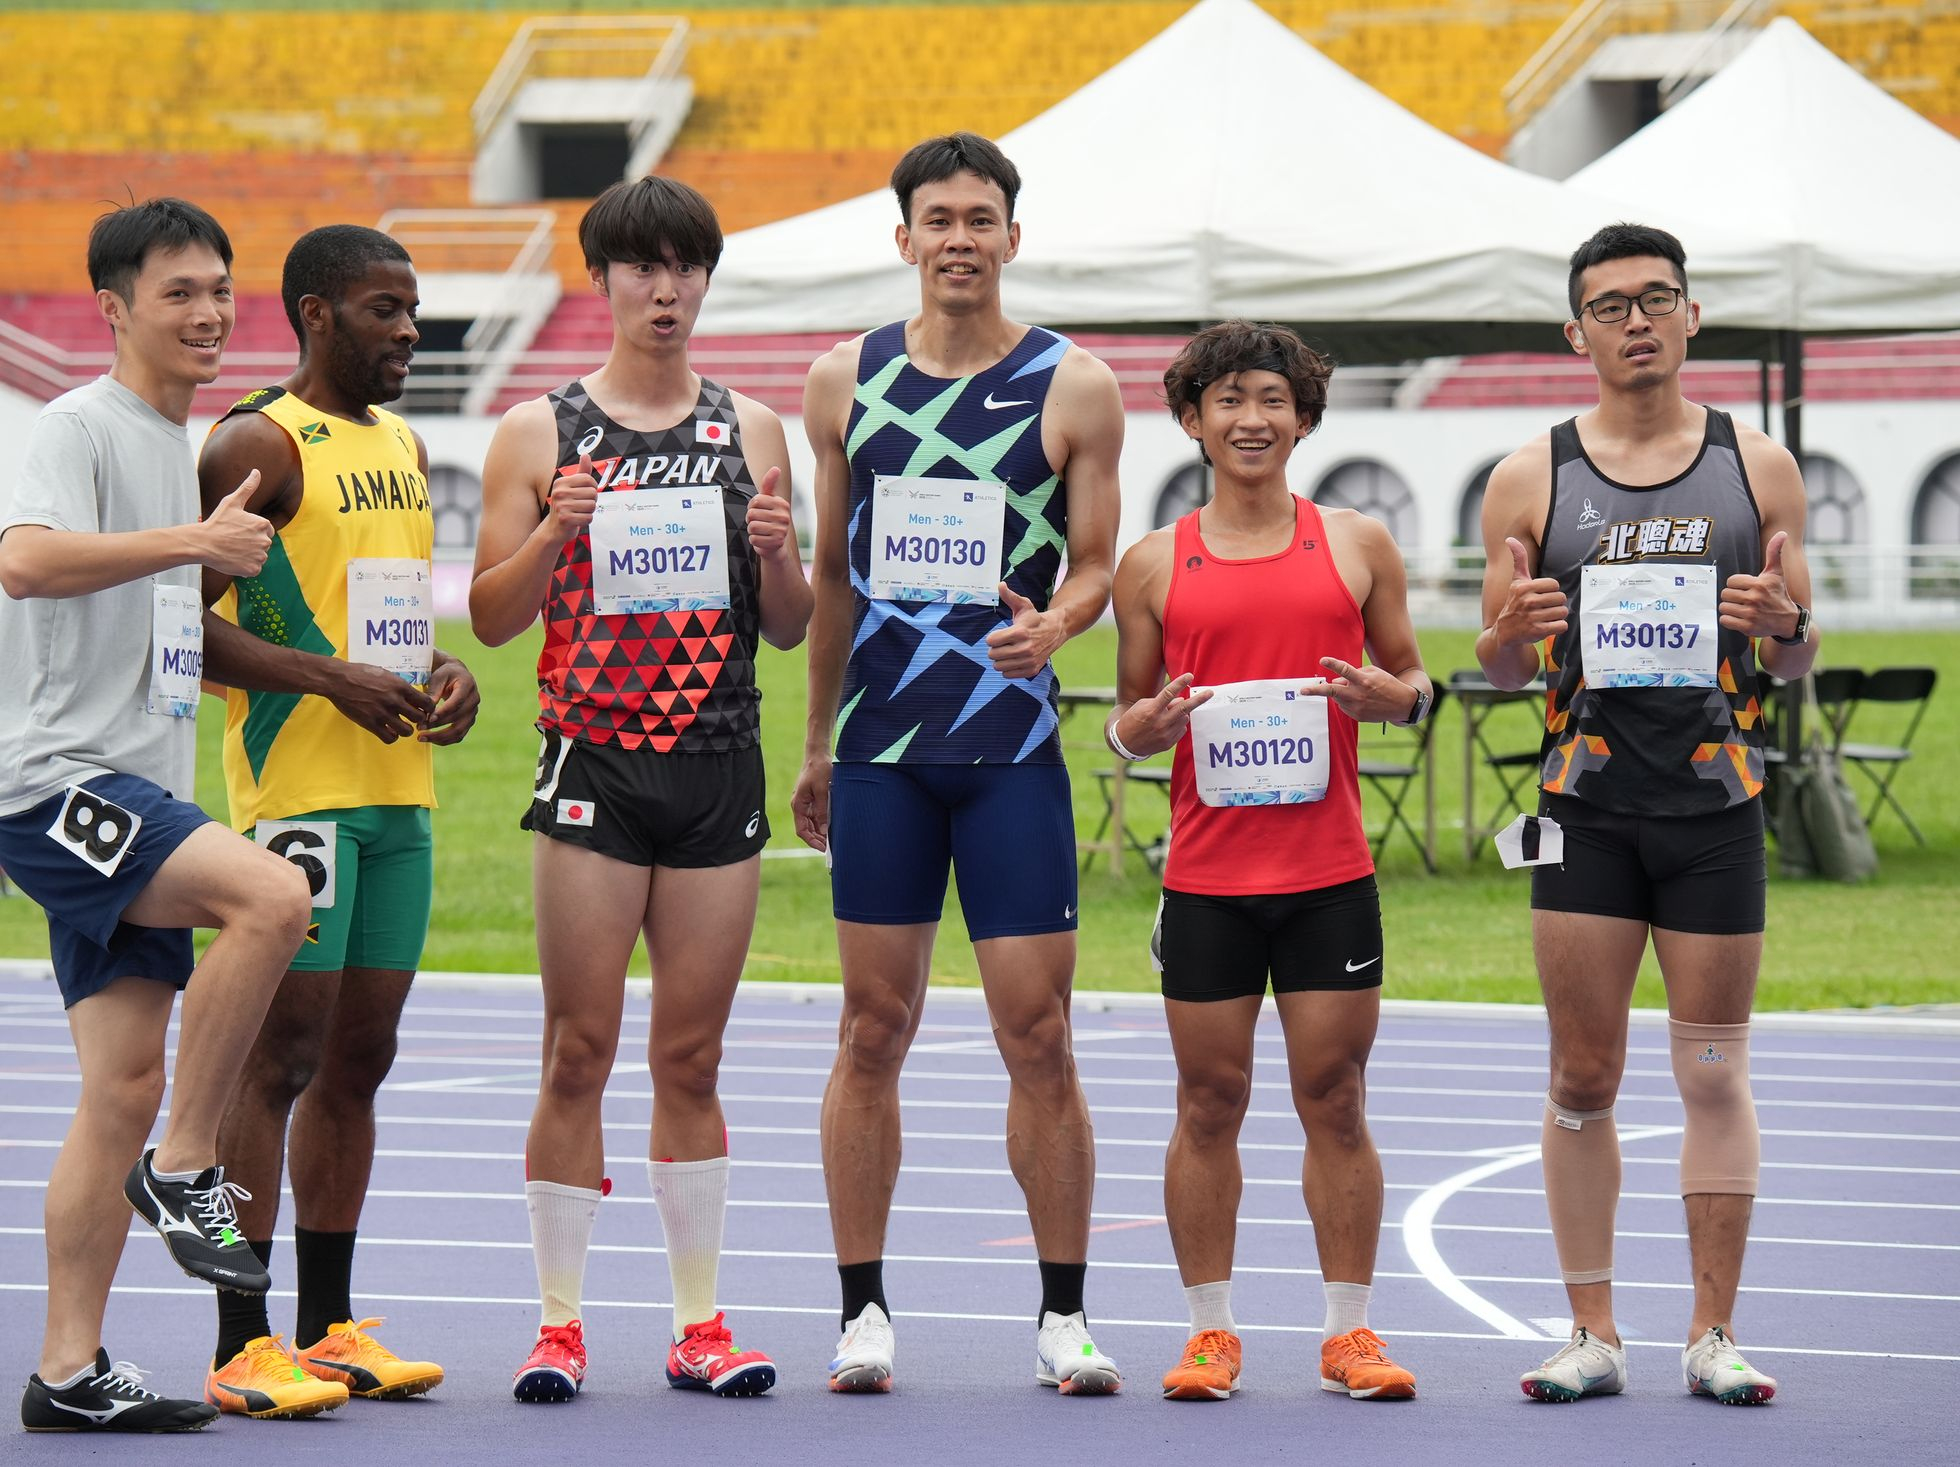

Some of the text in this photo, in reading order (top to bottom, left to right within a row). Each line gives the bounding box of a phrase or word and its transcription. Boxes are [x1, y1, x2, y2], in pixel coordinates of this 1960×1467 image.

[597, 454, 721, 487] JAPAN
[336, 470, 432, 513] JAMAICA
[629, 525, 654, 537] Men
[665, 523, 686, 535] 30+
[909, 513, 932, 525] Men
[943, 515, 964, 527] 30+
[609, 545, 711, 576] M30127
[885, 535, 986, 566] M30130
[384, 596, 405, 606] Men
[1619, 600, 1643, 611] Men
[1655, 600, 1677, 611] 30+
[366, 619, 429, 646] M30131
[1596, 622, 1700, 650] M30137
[1231, 717, 1255, 729] Men
[1267, 715, 1288, 728] 30+
[1209, 737, 1314, 769] M30120
